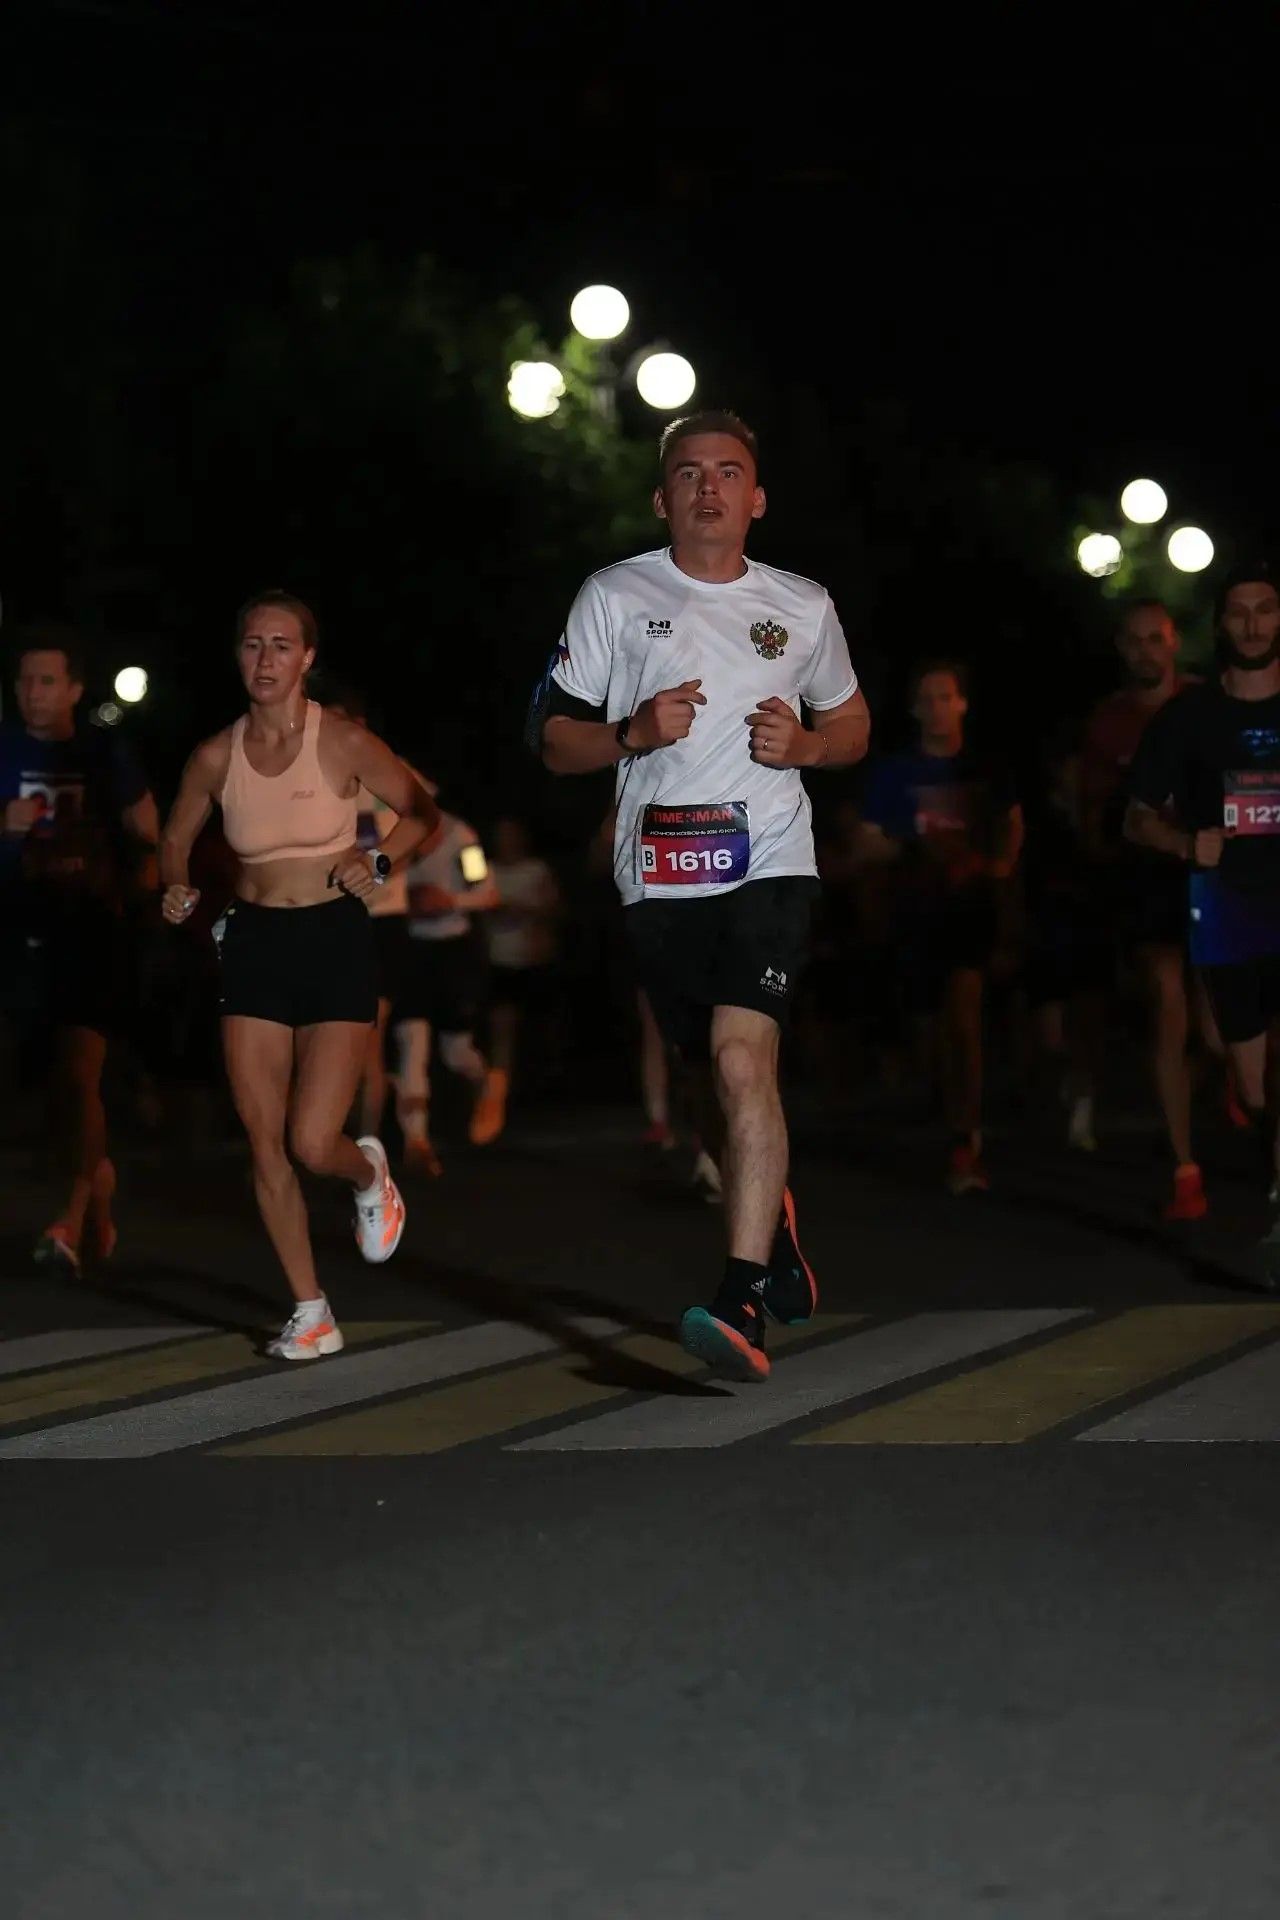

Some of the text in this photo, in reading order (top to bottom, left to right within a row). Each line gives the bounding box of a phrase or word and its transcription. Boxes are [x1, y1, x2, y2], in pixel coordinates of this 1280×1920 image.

[644, 849, 733, 872] B 1616
[759, 977, 788, 994] SPORT
